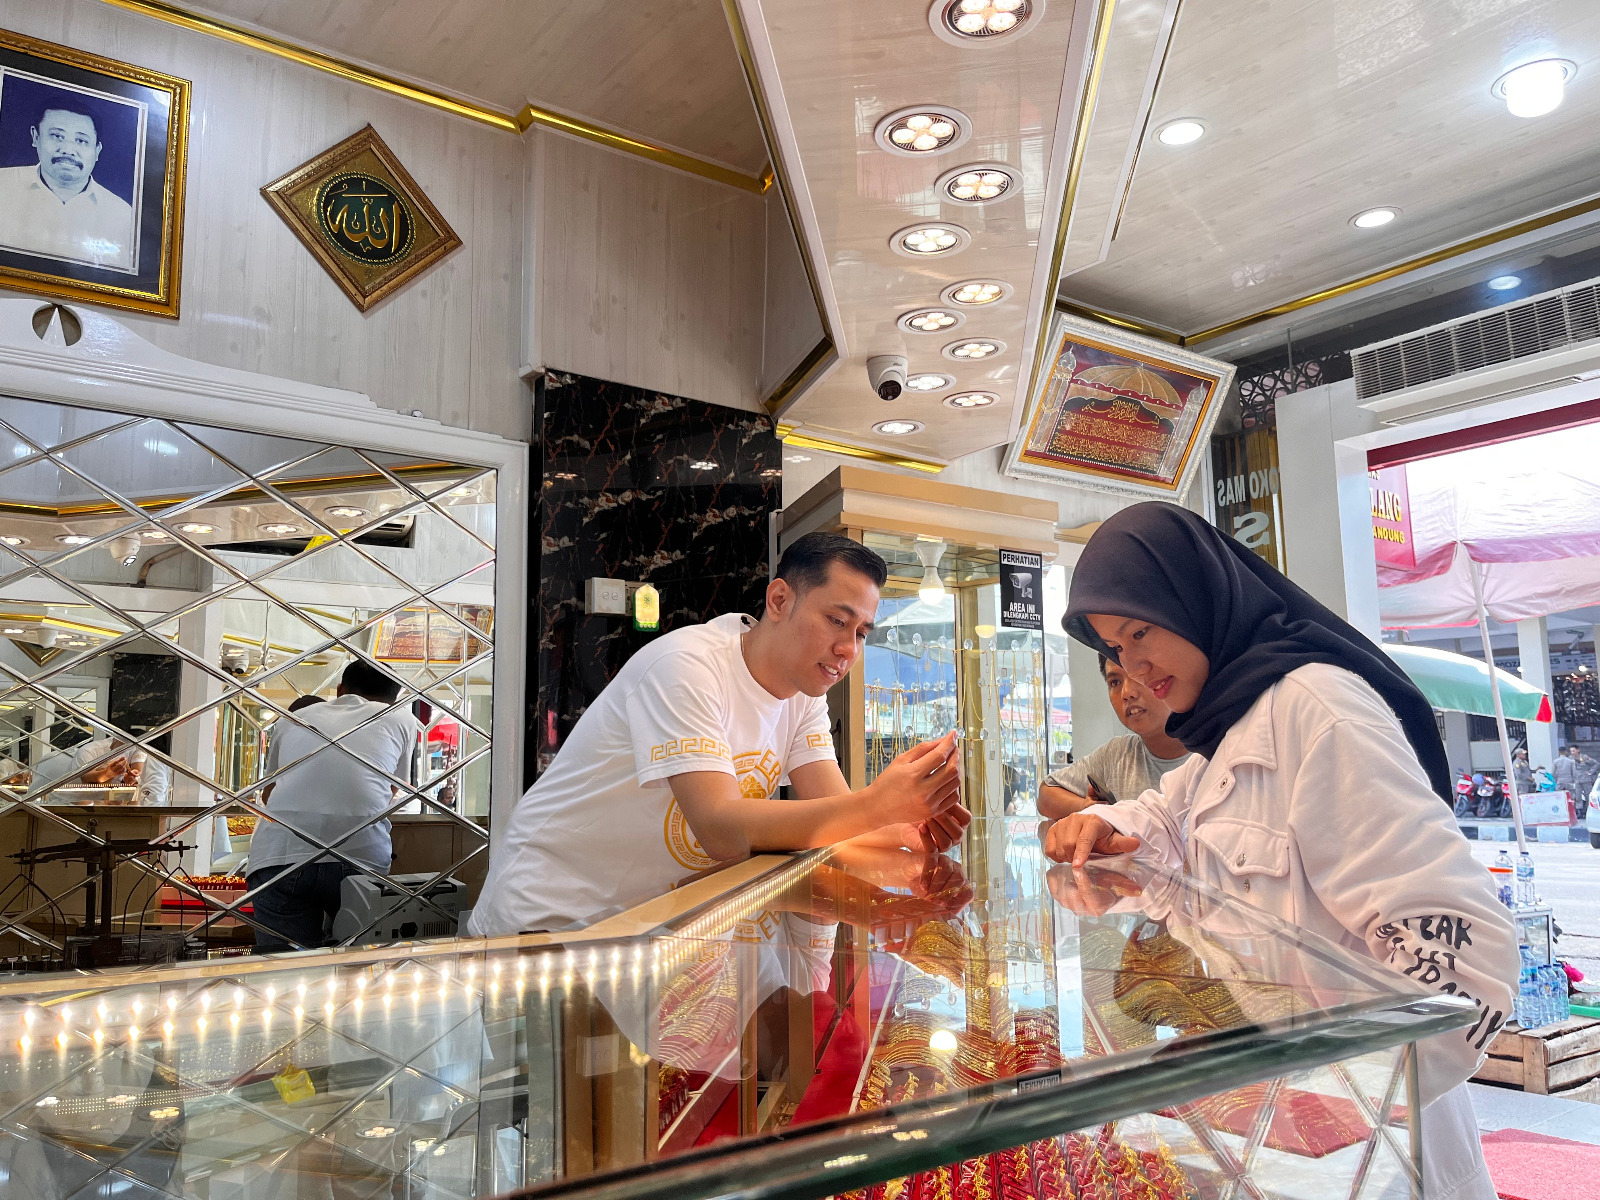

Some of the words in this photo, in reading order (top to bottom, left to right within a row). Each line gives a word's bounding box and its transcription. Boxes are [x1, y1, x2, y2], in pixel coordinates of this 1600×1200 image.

[1002, 553, 1039, 566] PERHATIAN
[1009, 602, 1026, 613] AREA
[1026, 604, 1036, 614] INI
[1029, 613, 1041, 621] CCTV
